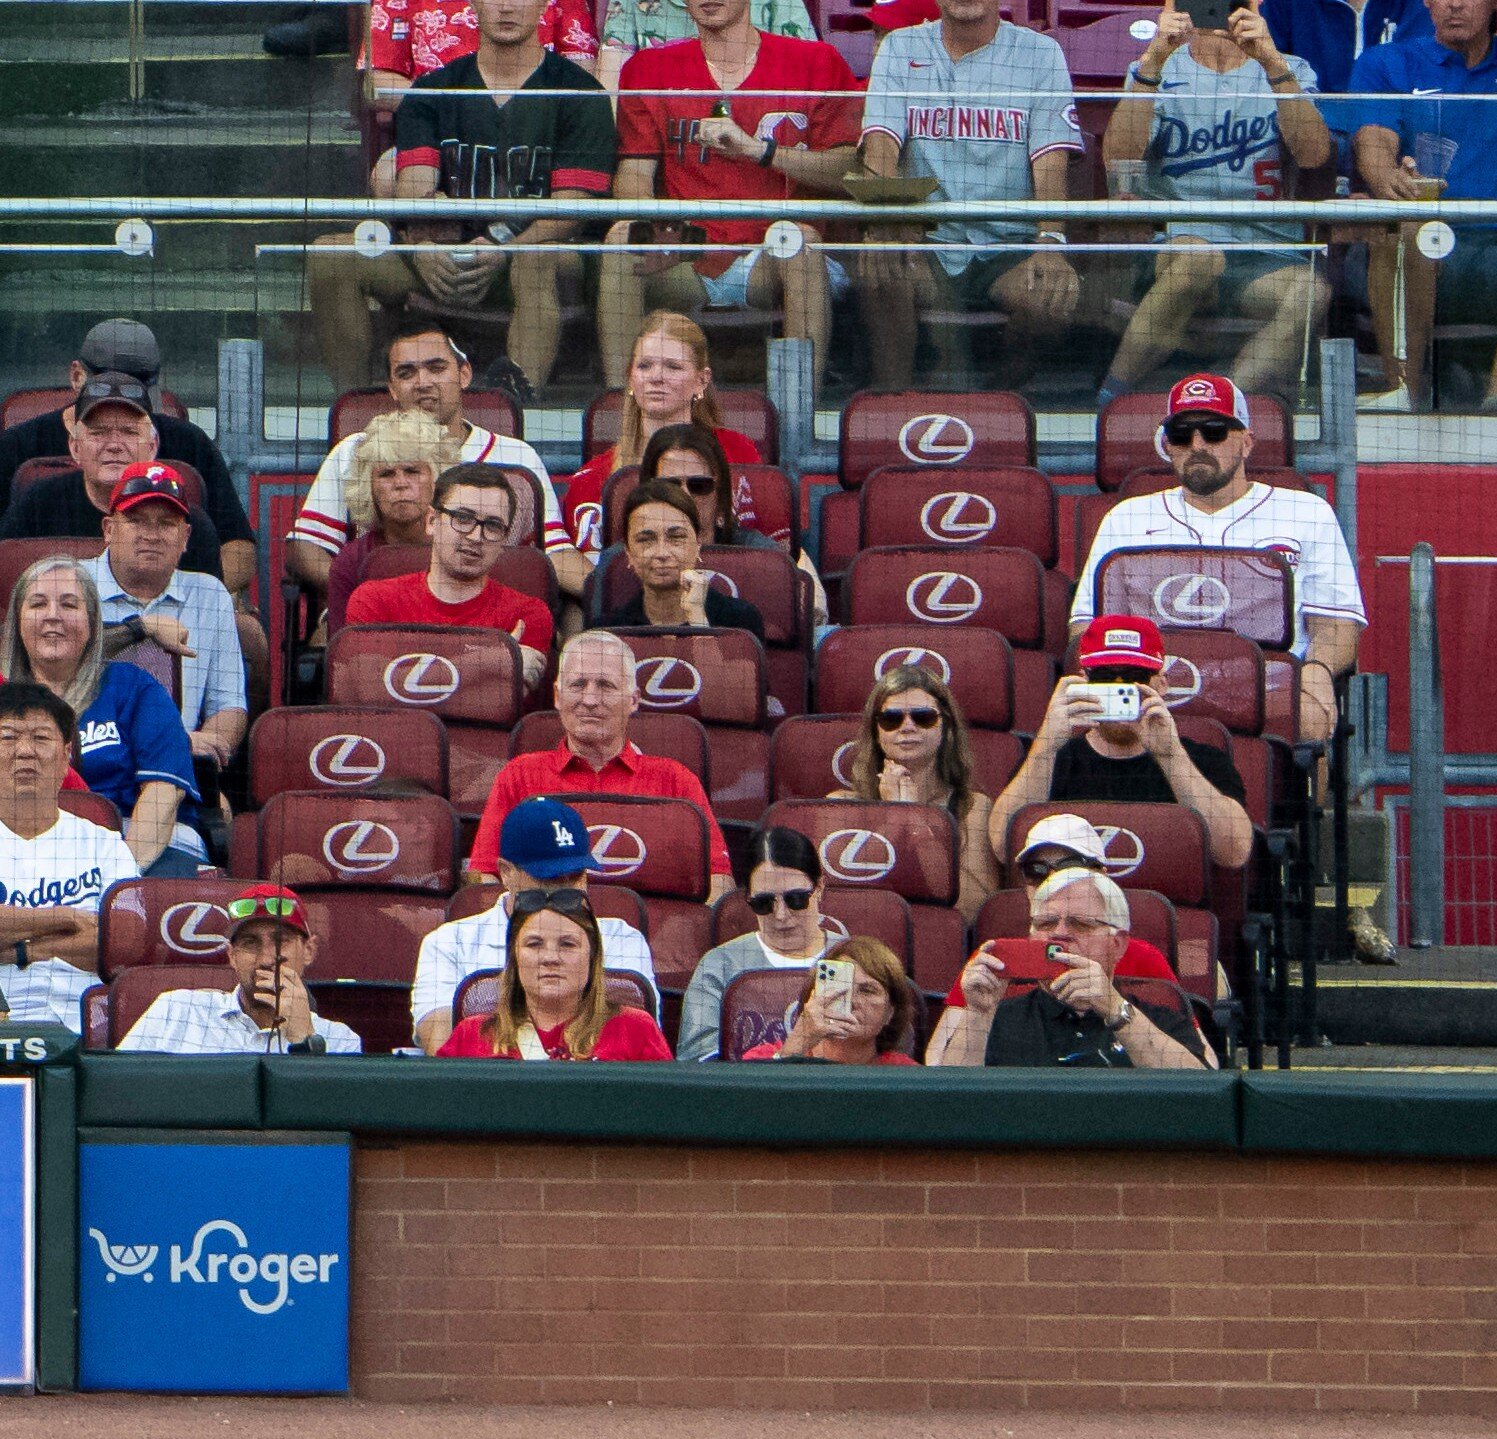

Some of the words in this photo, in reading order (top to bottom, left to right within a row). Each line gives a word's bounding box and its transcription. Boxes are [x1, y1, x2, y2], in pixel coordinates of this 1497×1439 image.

[1157, 107, 1280, 176] Dodger
[1251, 160, 1281, 200] 5
[551, 819, 577, 847] LA
[170, 1219, 339, 1315] Kroger
